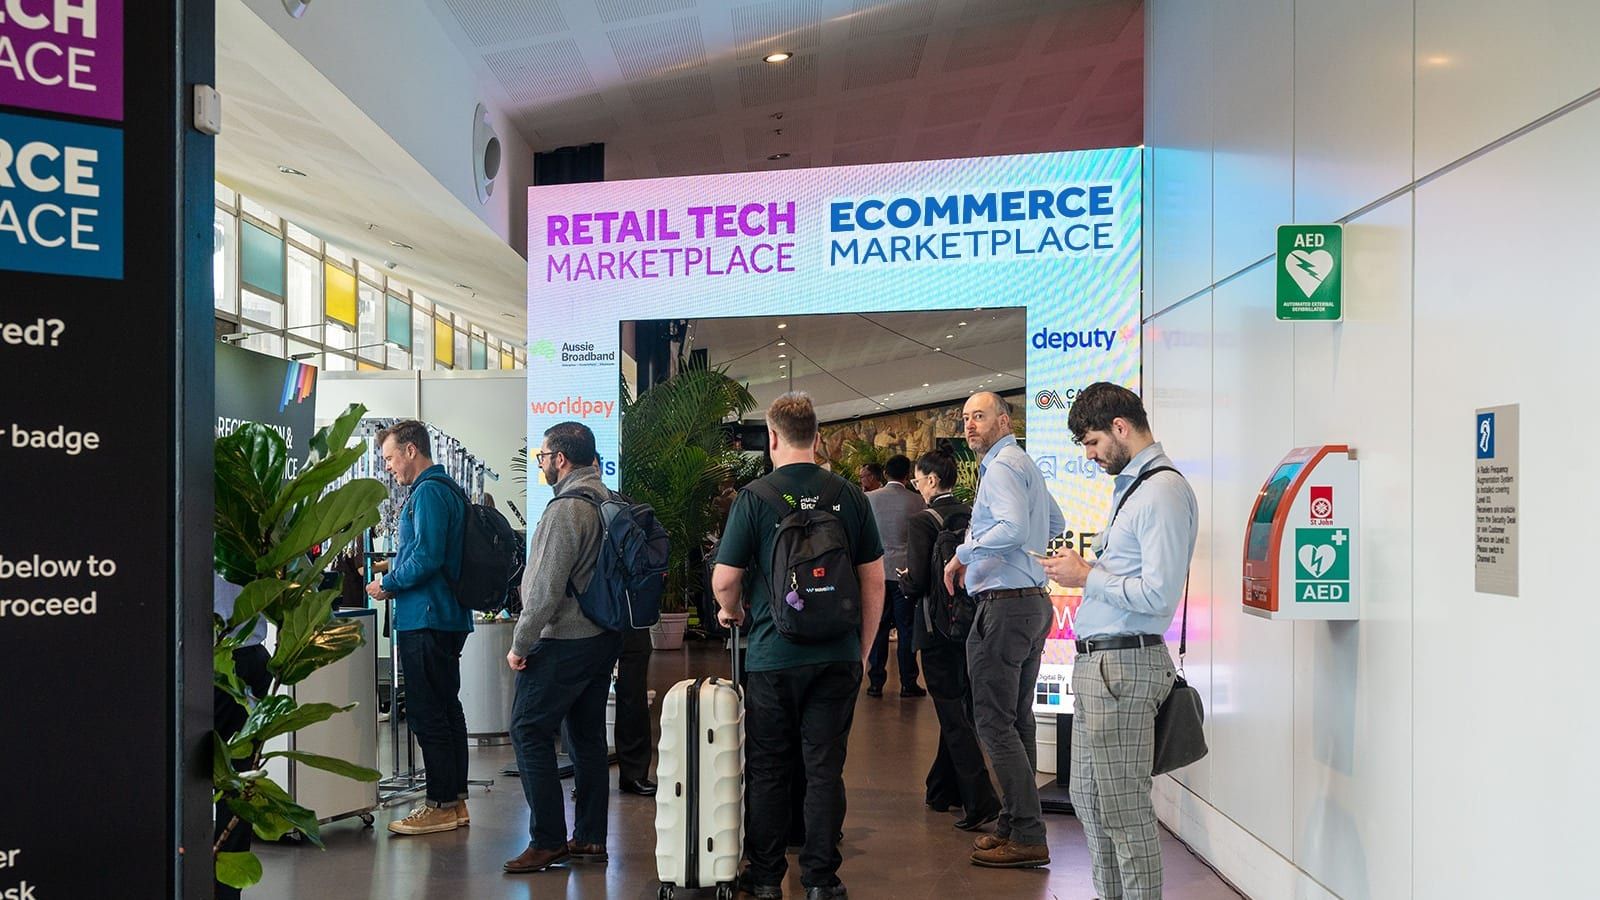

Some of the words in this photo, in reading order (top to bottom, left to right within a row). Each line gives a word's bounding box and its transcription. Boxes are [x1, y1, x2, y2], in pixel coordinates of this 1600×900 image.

[0, 0, 97, 39] CH
[830, 186, 1114, 233] ECOMMERCE
[547, 208, 680, 246] RETAIL
[687, 201, 796, 239] TECH
[830, 223, 1114, 266] MARKETPLACE
[1294, 233, 1325, 248] AED
[547, 242, 796, 282] MARKETPLACE
[0, 318, 65, 346] ed?
[1031, 327, 1117, 352] deputy
[561, 341, 594, 351] Aussie
[561, 351, 615, 361] Broadband
[531, 396, 615, 418] worldpay
[12, 424, 100, 455] badge
[1310, 518, 1317, 526] St
[1318, 518, 1334, 526] John
[0, 554, 81, 579] below
[87, 555, 117, 578] to
[0, 591, 97, 617] roceed
[1302, 584, 1343, 600] AED
